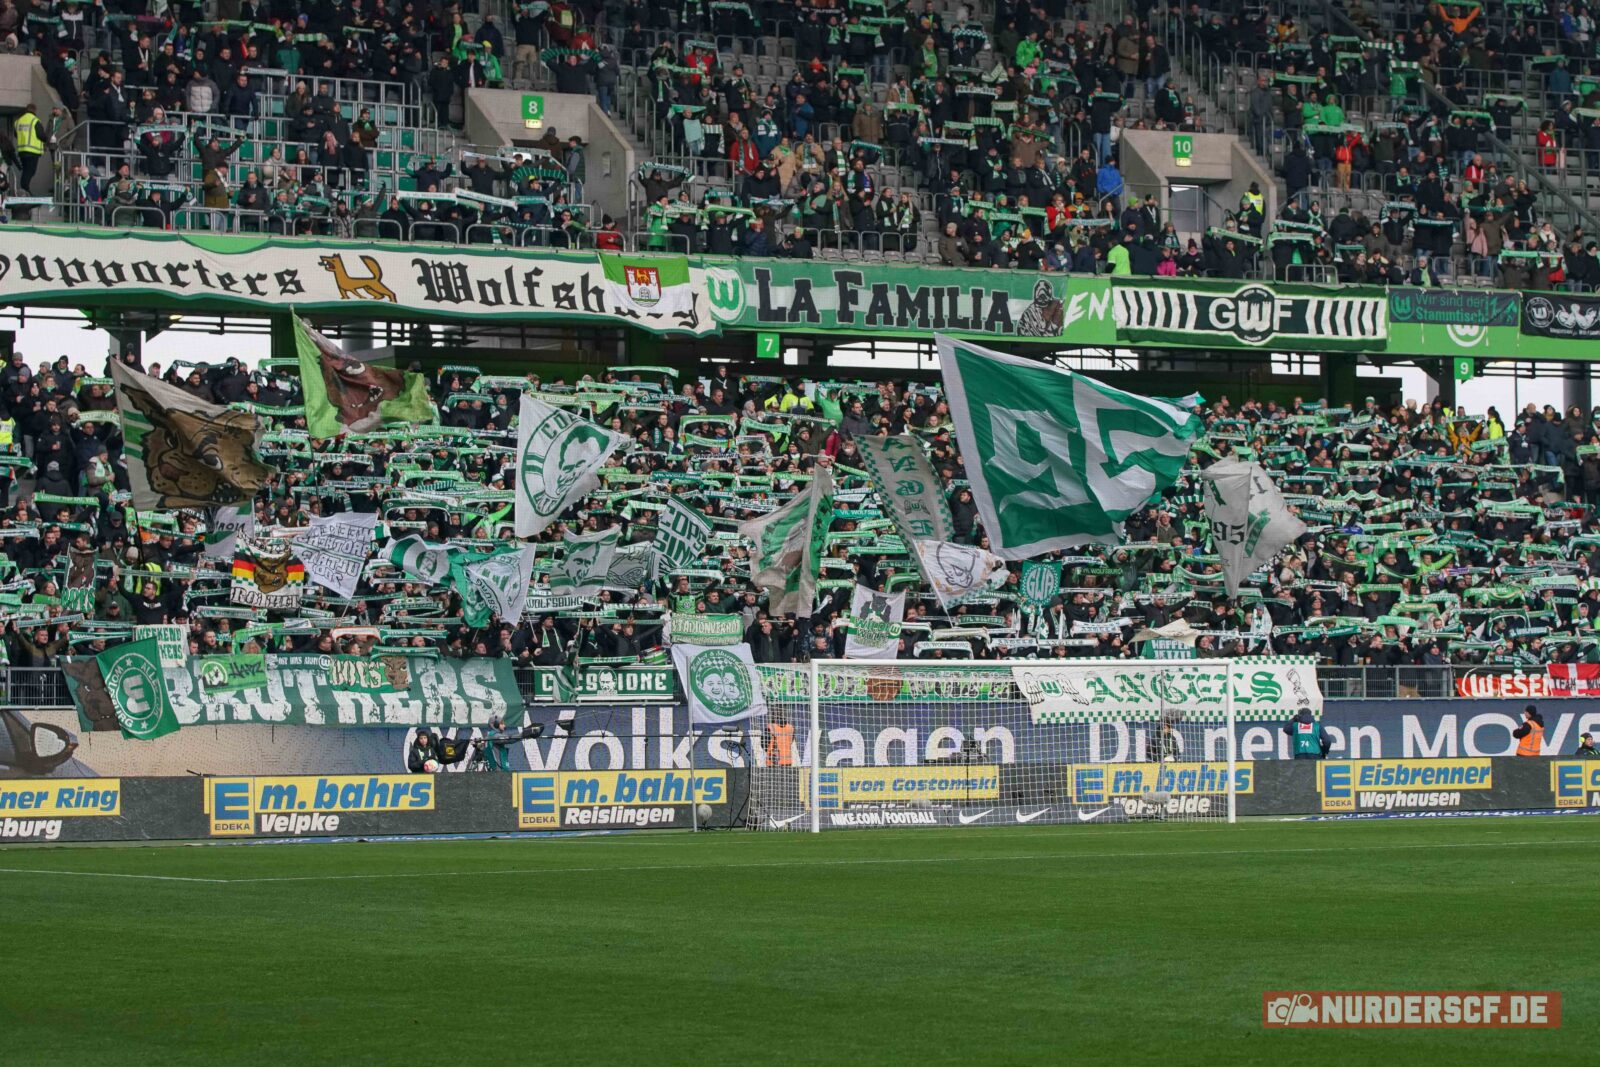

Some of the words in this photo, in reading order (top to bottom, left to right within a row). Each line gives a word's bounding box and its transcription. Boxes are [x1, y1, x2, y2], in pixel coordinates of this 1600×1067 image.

[528, 101, 538, 114] 8
[1175, 141, 1191, 153] 10
[753, 267, 821, 323] LA
[832, 269, 1014, 335] FAMILIA
[764, 338, 773, 352] 7
[1460, 362, 1469, 375] 9
[1213, 521, 1246, 546] 95
[530, 597, 583, 610] WOLFSBURG
[1300, 740, 1309, 748] 74
[849, 779, 885, 793] von
[892, 775, 997, 792] Gostomski
[1359, 764, 1490, 787] Eisbrenner
[260, 784, 307, 810] m.
[313, 778, 432, 809] bahrs
[564, 776, 608, 803] m.
[614, 773, 723, 802] bahrs
[56, 786, 118, 812] Ring
[1325, 799, 1353, 808] EDEKA
[1360, 791, 1461, 811] Weyhausen
[261, 813, 340, 834] Velpke
[522, 816, 556, 824] EDEKA
[565, 807, 675, 826] Reislingen
[215, 822, 250, 831] EDEKA
